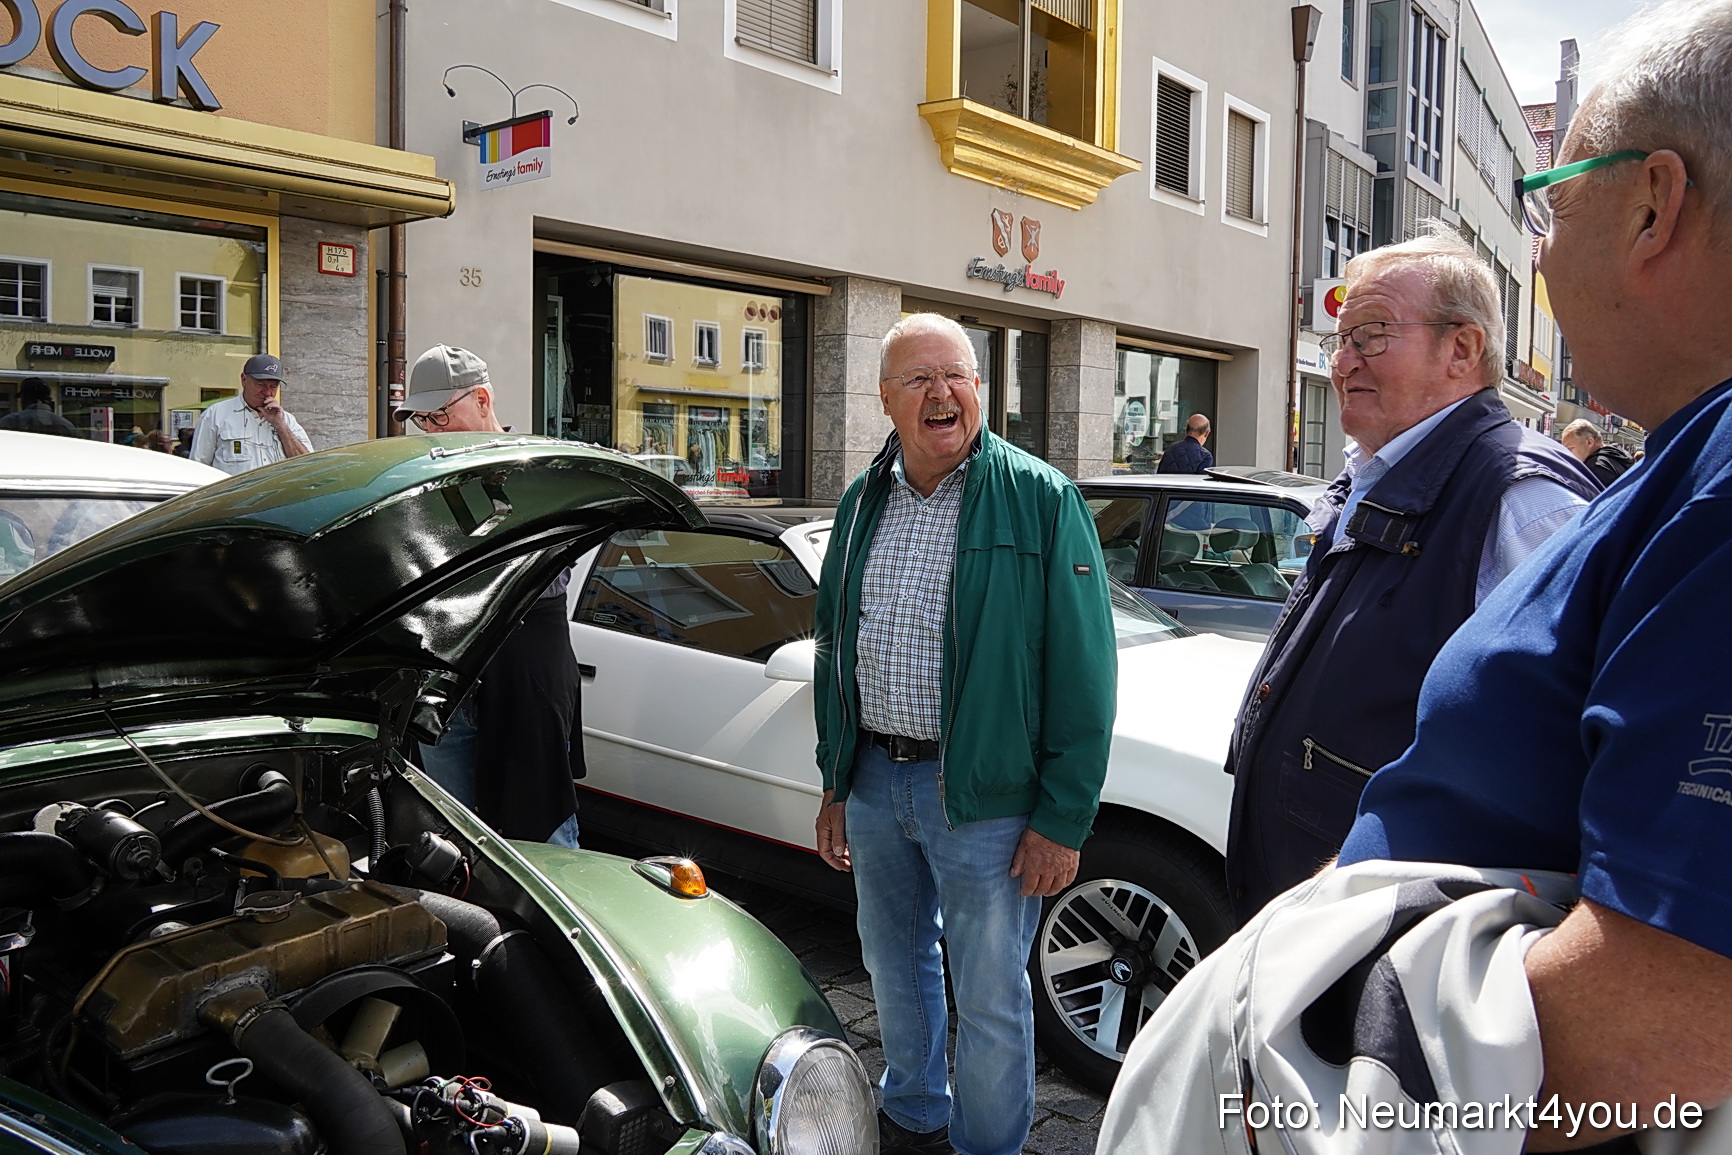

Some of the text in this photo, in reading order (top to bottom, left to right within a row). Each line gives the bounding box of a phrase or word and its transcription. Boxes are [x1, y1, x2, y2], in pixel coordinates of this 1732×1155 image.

[485, 156, 544, 182] Ernsting's family
[460, 266, 482, 287] 35
[966, 257, 1065, 299] Ernsting's family
[717, 468, 750, 485] family
[1677, 781, 1732, 806] TECHNICA
